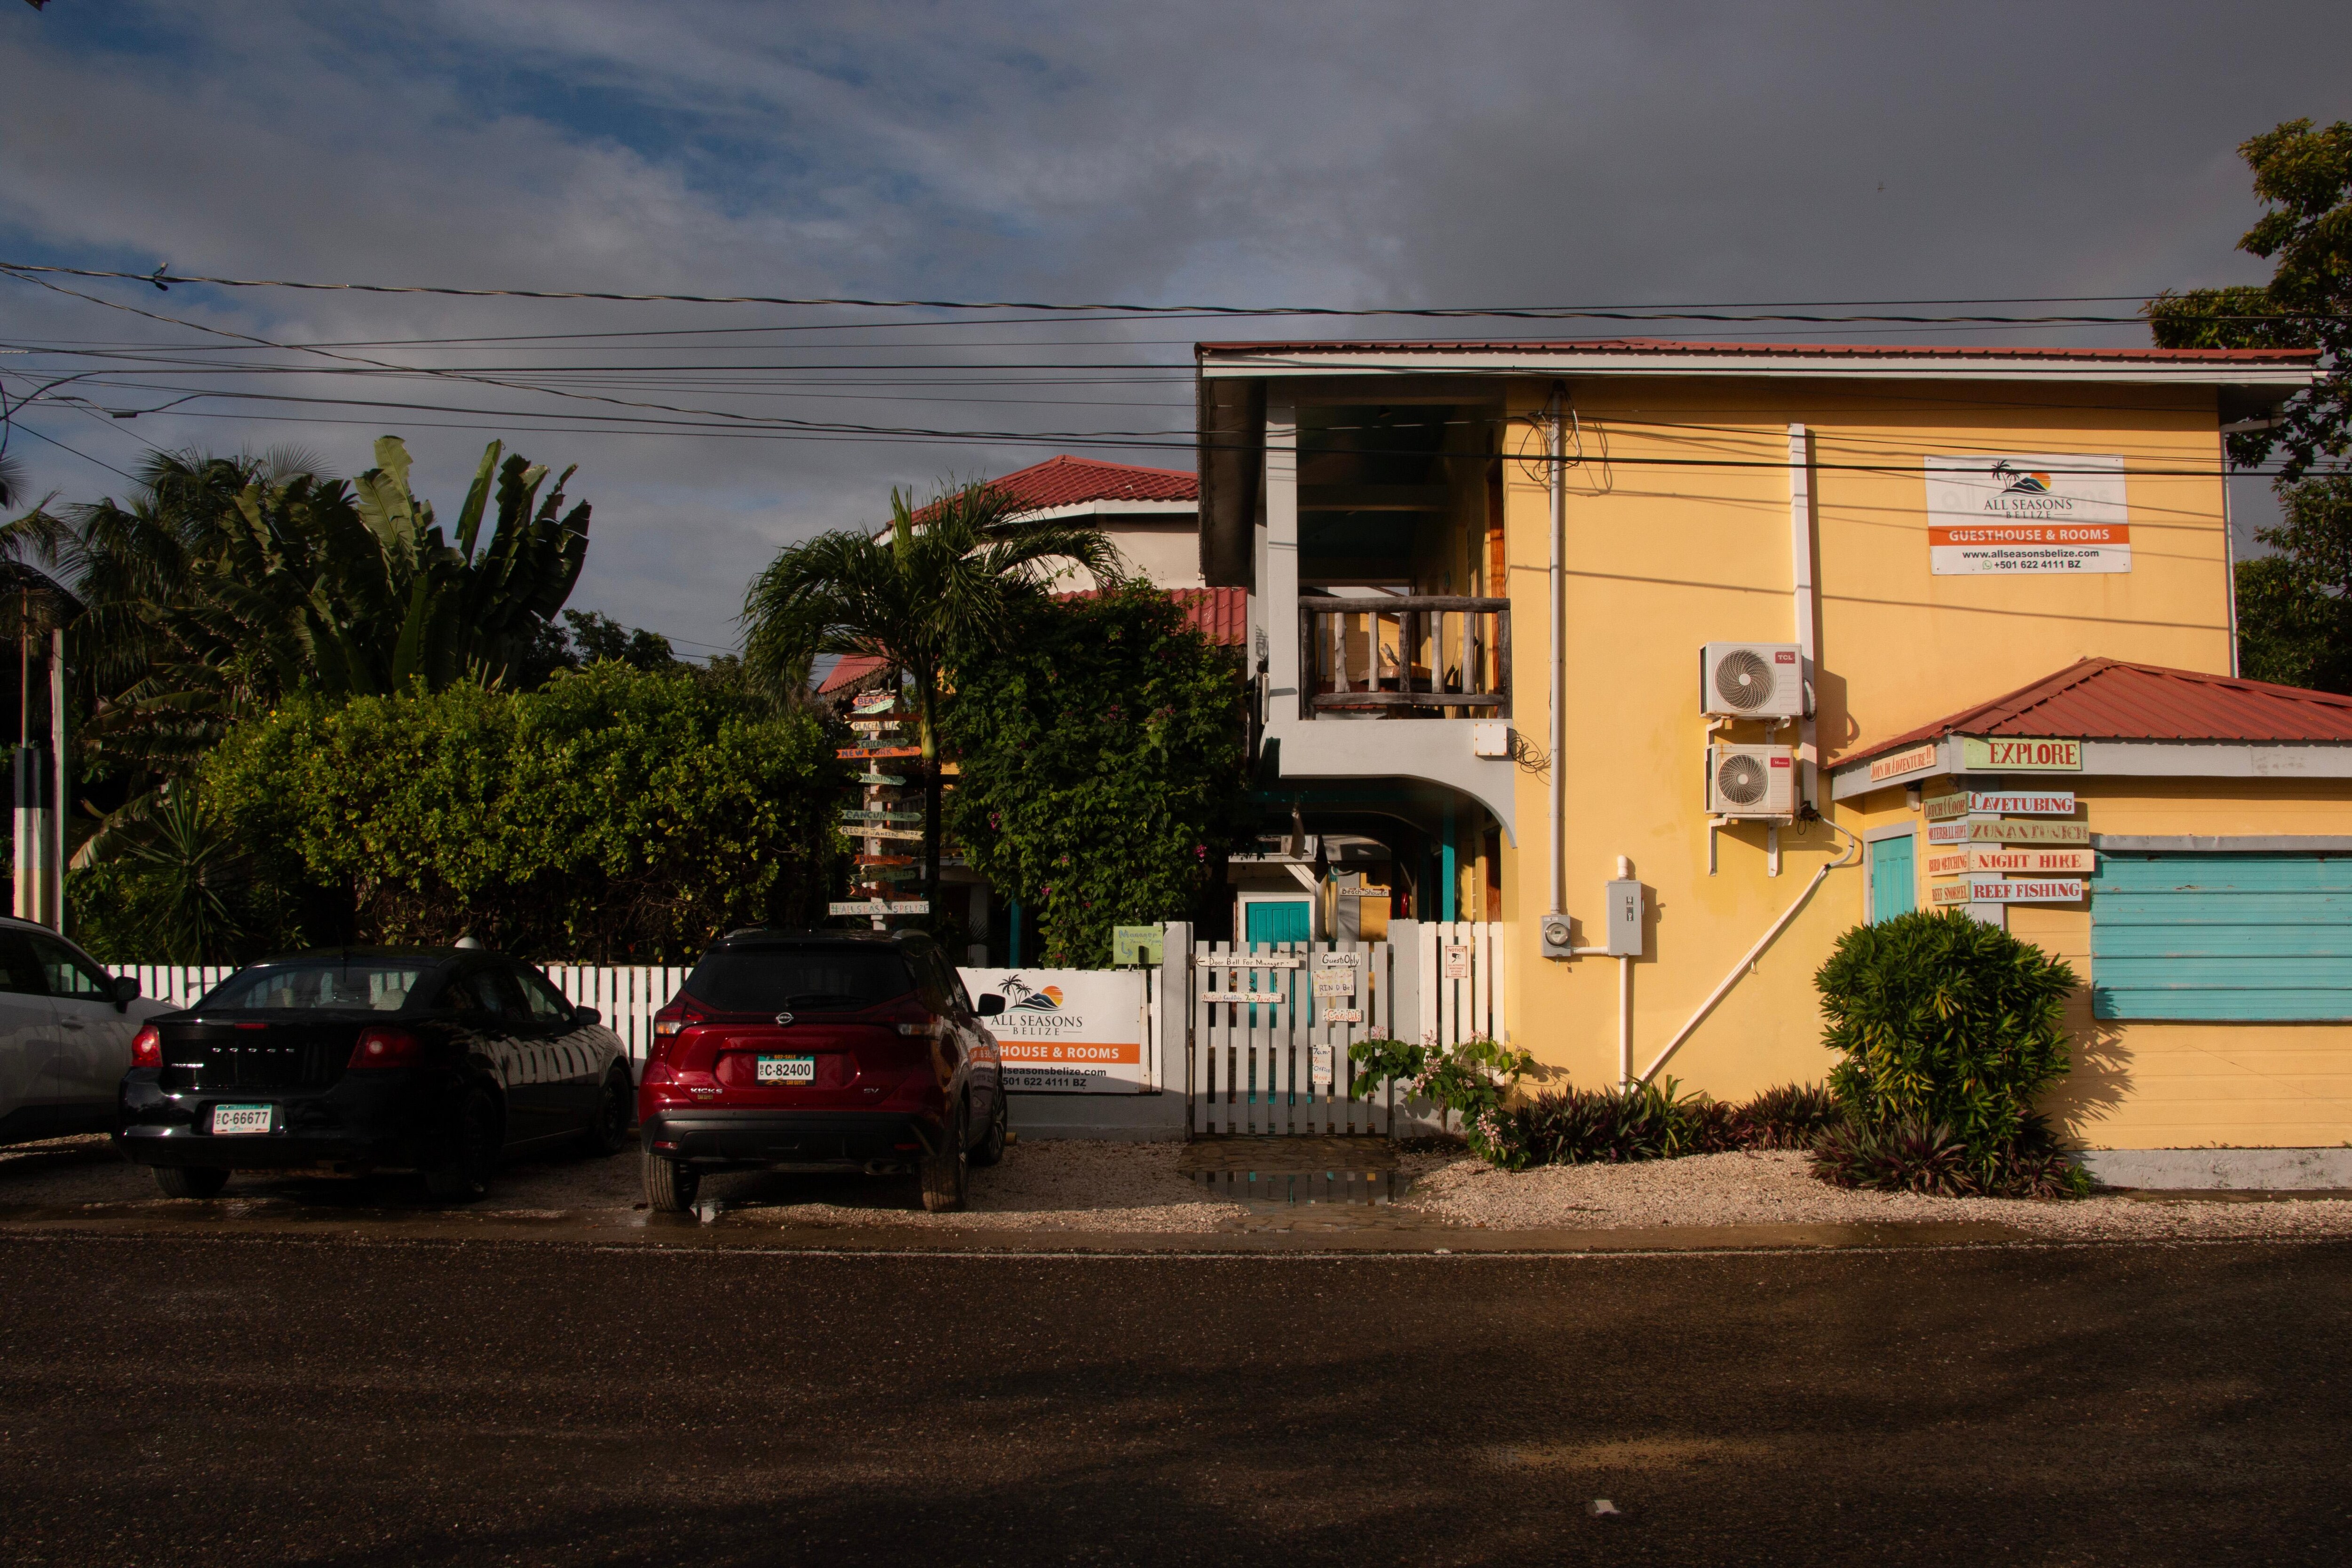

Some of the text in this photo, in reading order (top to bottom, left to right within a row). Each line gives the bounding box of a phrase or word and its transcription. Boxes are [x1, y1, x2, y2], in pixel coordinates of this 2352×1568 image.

[1984, 499, 2073, 510] ALL SEASONS
[1949, 529, 2109, 541] GUESTHOUSE & ROOMS
[1962, 549, 2099, 558] www.allseasonsbelize.com
[1994, 560, 2017, 569] +501
[2067, 560, 2081, 568] BZ
[854, 722, 898, 731] PLACENCIA
[1990, 743, 2077, 765] EXPLORE
[1870, 762, 1883, 780] JOIN
[1923, 801, 1943, 818] CATCH
[1947, 797, 1965, 814] COOK
[1971, 792, 2073, 812] CAVETUBING
[846, 811, 886, 820] CANCUN
[871, 829, 898, 838] JANEIRO
[1928, 825, 1967, 840] WATERFALL HIKE
[1929, 855, 1967, 872] BIRD WATCHING
[1978, 854, 2081, 868] NIGHT HIKE
[1932, 885, 1968, 902] REEF SNORKEL
[1973, 883, 2080, 898] REEF FISHING
[1119, 929, 1158, 940] Manager
[1322, 954, 1359, 966] Guests Only
[990, 1014, 1083, 1027] ALL SEASONS
[1347, 1011, 1361, 1021] Only
[1013, 1027, 1060, 1035] BELIZE
[1052, 1047, 1063, 1058] &
[1067, 1047, 1120, 1059] ROOMS
[765, 1064, 810, 1076] C-82400
[1045, 1078, 1070, 1086] 4111
[222, 1111, 269, 1125] C-66677
